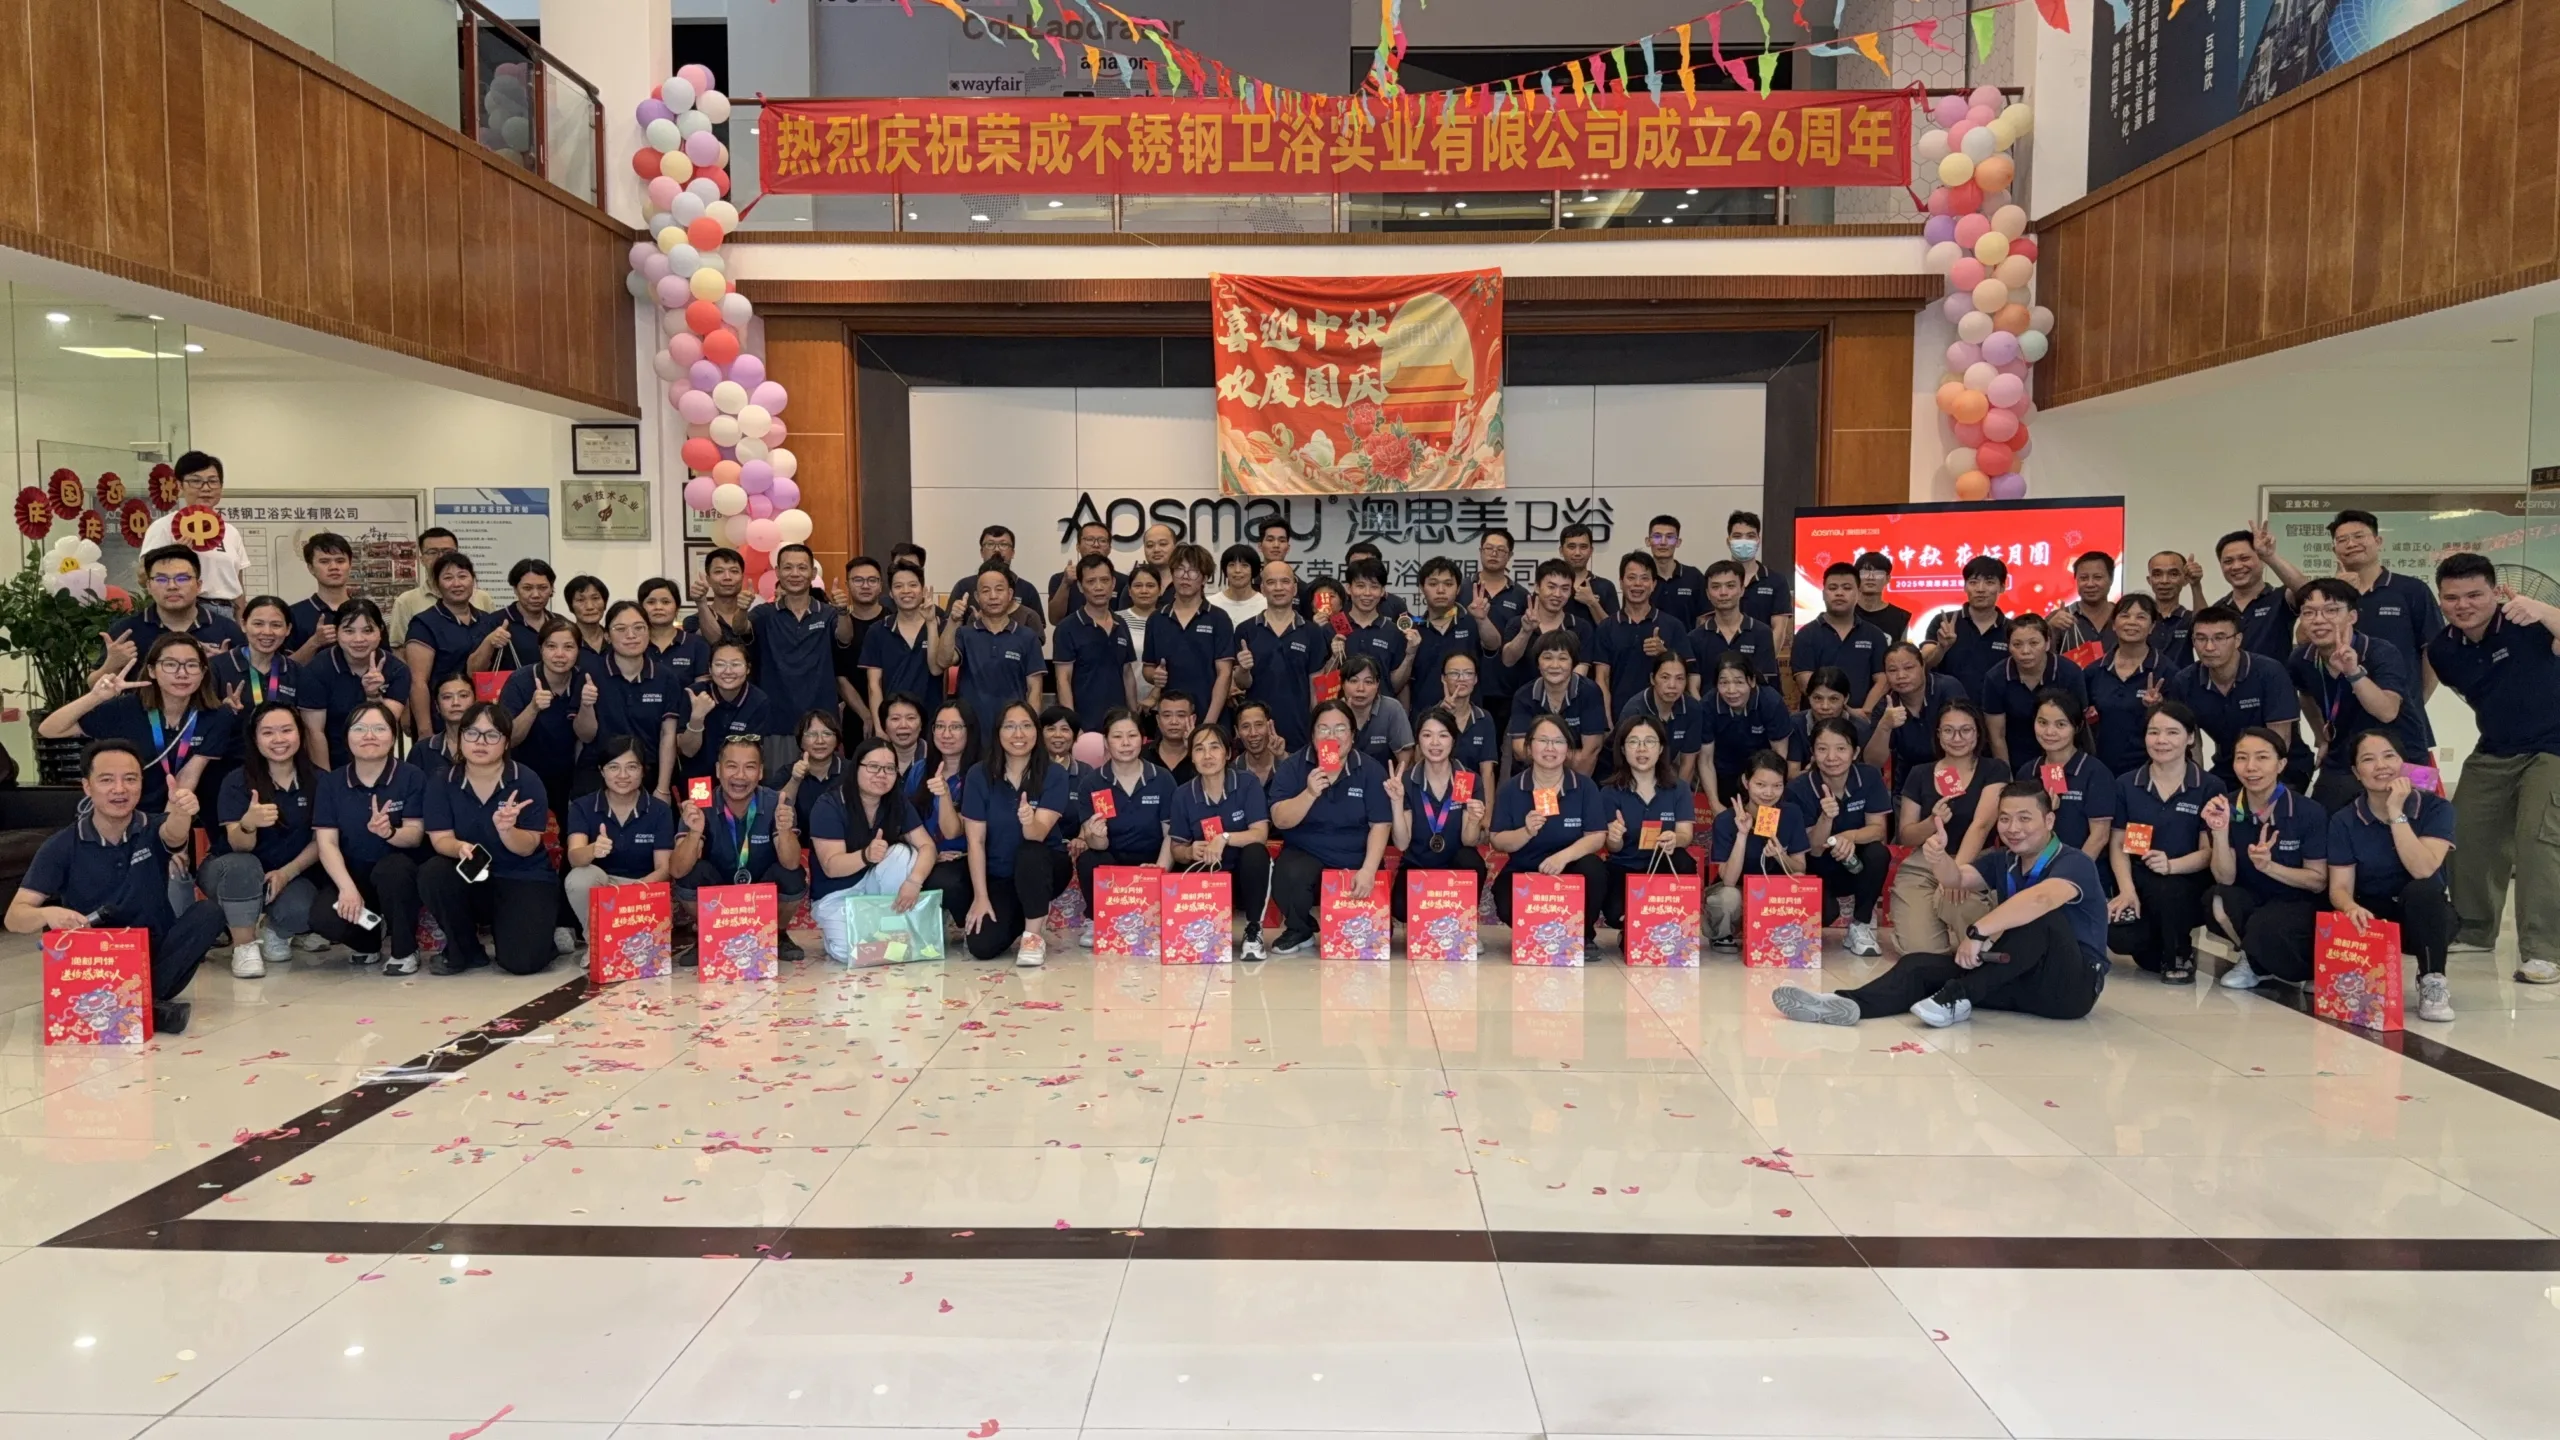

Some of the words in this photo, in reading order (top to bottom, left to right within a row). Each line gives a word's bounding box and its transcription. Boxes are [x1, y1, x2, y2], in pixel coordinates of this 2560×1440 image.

[1080, 55, 1148, 71] amaon
[962, 76, 1022, 92] wayfair
[776, 106, 1895, 176] 热烈庆祝荣成不锈钢卫浴实业有限公司成立26周年
[1217, 303, 1388, 352] 喜迎中秋
[1217, 363, 1389, 410] 欢度国庆
[215, 506, 359, 520] 不锈钢卫浴实业有限公司
[571, 490, 640, 513] 高新技术企业
[179, 510, 220, 546] 中
[1345, 496, 1614, 545] 澳思美卫浴
[2286, 523, 2331, 537] 管理理
